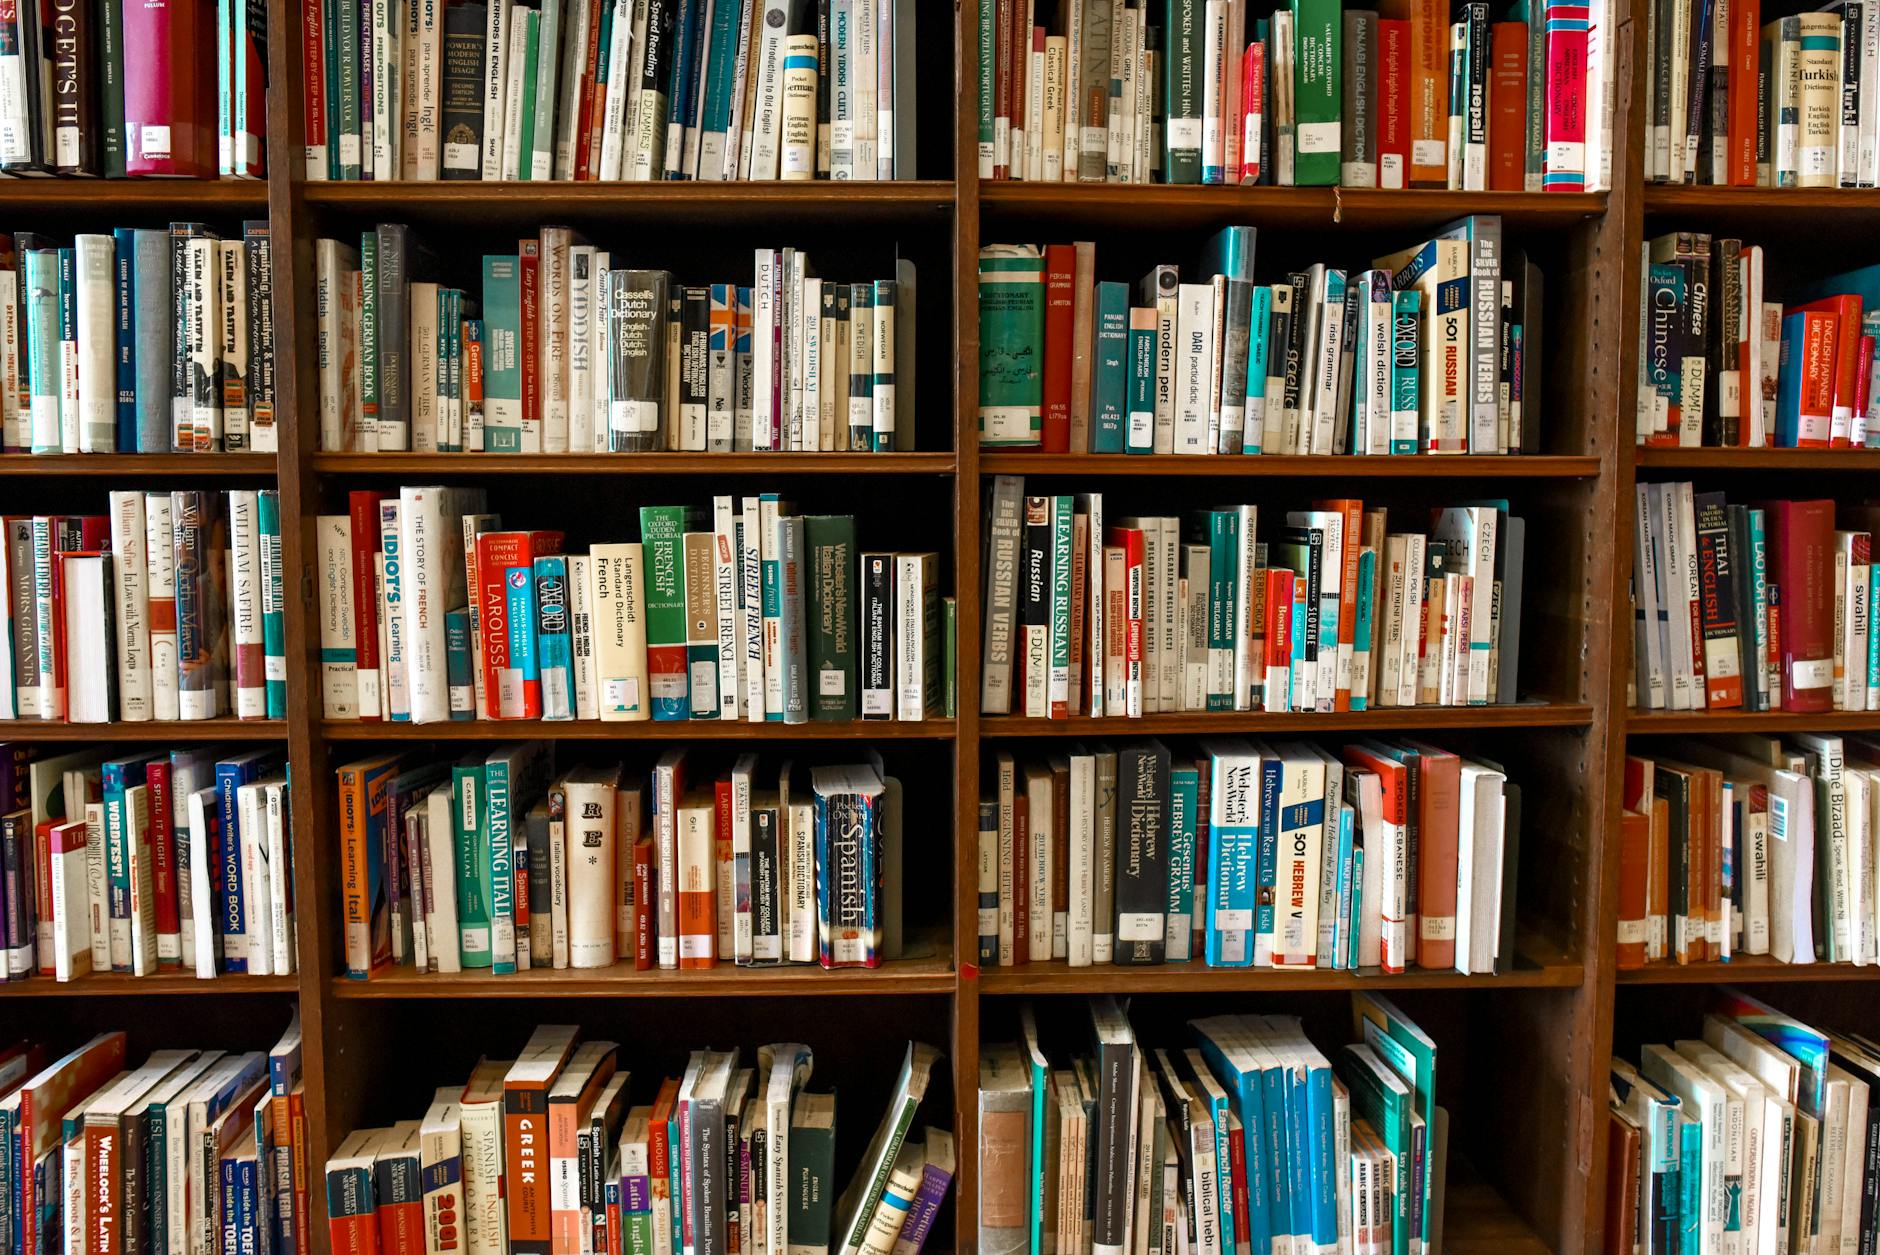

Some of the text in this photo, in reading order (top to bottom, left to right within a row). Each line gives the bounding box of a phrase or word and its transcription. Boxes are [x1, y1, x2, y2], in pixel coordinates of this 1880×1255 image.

[363, 3, 371, 73] PERFECT PHRASES
[376, 2, 384, 28] OUTS
[645, 1, 662, 78] Speed Reading
[838, 11, 847, 50] MODERN
[1867, 1, 1877, 57] FINNISH
[408, 49, 418, 66] para
[490, 55, 499, 100] ENGLISH
[491, 42, 499, 53] IN
[838, 54, 847, 87] YIDDISH
[982, 19, 991, 124] BRAZILIAN PORTUGUESE
[1047, 47, 1056, 111] Classical Greek
[1182, 0, 1193, 97] SPOKEN and WRITTEN
[58, 101, 78, 124] II
[408, 70, 418, 107] aprender
[1469, 84, 1486, 142] nepali
[640, 99, 652, 150] DUMMIES
[63, 293, 73, 340] how we talk
[121, 281, 128, 289] OF
[121, 290, 129, 307] BLACK
[225, 250, 236, 354] TALKIN AND TESTIFYIN
[551, 243, 566, 362] WORDS ON FIRE
[610, 309, 657, 321] Dictionary
[621, 299, 648, 309] Dutch
[760, 264, 770, 310] DUTCH
[1691, 282, 1707, 336] Chinese
[121, 307, 129, 330] ENGLISH
[319, 278, 330, 370] Yiddish English
[364, 251, 374, 399] LEARNING GERMAN BOOK
[572, 282, 589, 371] YIDDISH
[879, 320, 887, 361] NORWEGIAN
[1394, 318, 1418, 367] OXFORD
[1477, 280, 1495, 403] RUSSIAN VERBS
[1653, 286, 1678, 382] Chinese
[698, 331, 708, 398] AFRIKAANS/ENGLISH
[1186, 331, 1204, 385] DARI practical
[1324, 323, 1338, 392] irish grammar
[35, 522, 51, 599] RICHARD LEDERER
[121, 499, 141, 647] William Safire In Love with Norma
[235, 503, 253, 634] WILLIAM SAFIRE
[415, 514, 428, 630] THE STORY OF FRENCH
[1481, 522, 1492, 562] CZECH
[1715, 534, 1730, 577] THAI
[383, 534, 403, 663] IDIOT'S Learning
[539, 581, 566, 631] OXFORD
[598, 557, 611, 599] French
[613, 557, 626, 648] Standard Dictionary
[624, 557, 637, 624] Langenscheidt
[745, 546, 762, 660] STREET FRENCH
[821, 545, 835, 636] Italian Dictionary
[1029, 549, 1044, 602] Russian
[1053, 515, 1074, 659] LEARNING RUSSIAN
[1255, 570, 1267, 632] SERBO-CROAT
[1687, 553, 1700, 598] KOREAN
[1702, 549, 1720, 622] ENGLISH
[1276, 605, 1288, 647] Bosnian
[1769, 608, 1780, 653] Mandarin
[1854, 585, 1868, 636] swahili
[153, 783, 167, 868] SPELL IT RIGHT
[465, 782, 474, 825] CASSELL'S
[1001, 770, 1013, 866] Held BEGINNING
[1237, 765, 1252, 824] Webster's
[1829, 756, 1846, 844] Diné Bizaad:
[108, 800, 123, 878] WORDFEST!
[223, 778, 240, 931] Children's Writer's WORD BOOK
[1396, 779, 1404, 882] SPOKEN LEBANESE
[1754, 830, 1767, 881] swahili
[176, 831, 193, 906] thesaurus
[552, 840, 565, 907] italian vocabulary
[796, 830, 807, 910] SPANISH DICTIONARY
[832, 822, 866, 924] Spanish
[1235, 834, 1254, 893] Hebrew
[1291, 832, 1307, 908] 501 HEBREW
[150, 1118, 163, 1141] ESL
[519, 1118, 535, 1184] GREEK
[1729, 1106, 1739, 1163] INDONESIAN
[276, 1146, 293, 1219] PHRASAL VERB
[463, 1131, 480, 1249] DICTIONARY
[483, 1130, 500, 1249] SPANISH ENGLISH
[628, 1177, 643, 1210] Latin
[701, 1127, 713, 1237] The Syntax of Spoken Brazilian
[1217, 1108, 1234, 1216] Easy French Reader
[437, 1193, 459, 1252] 2001
[1745, 1193, 1757, 1227] TAGALOG
